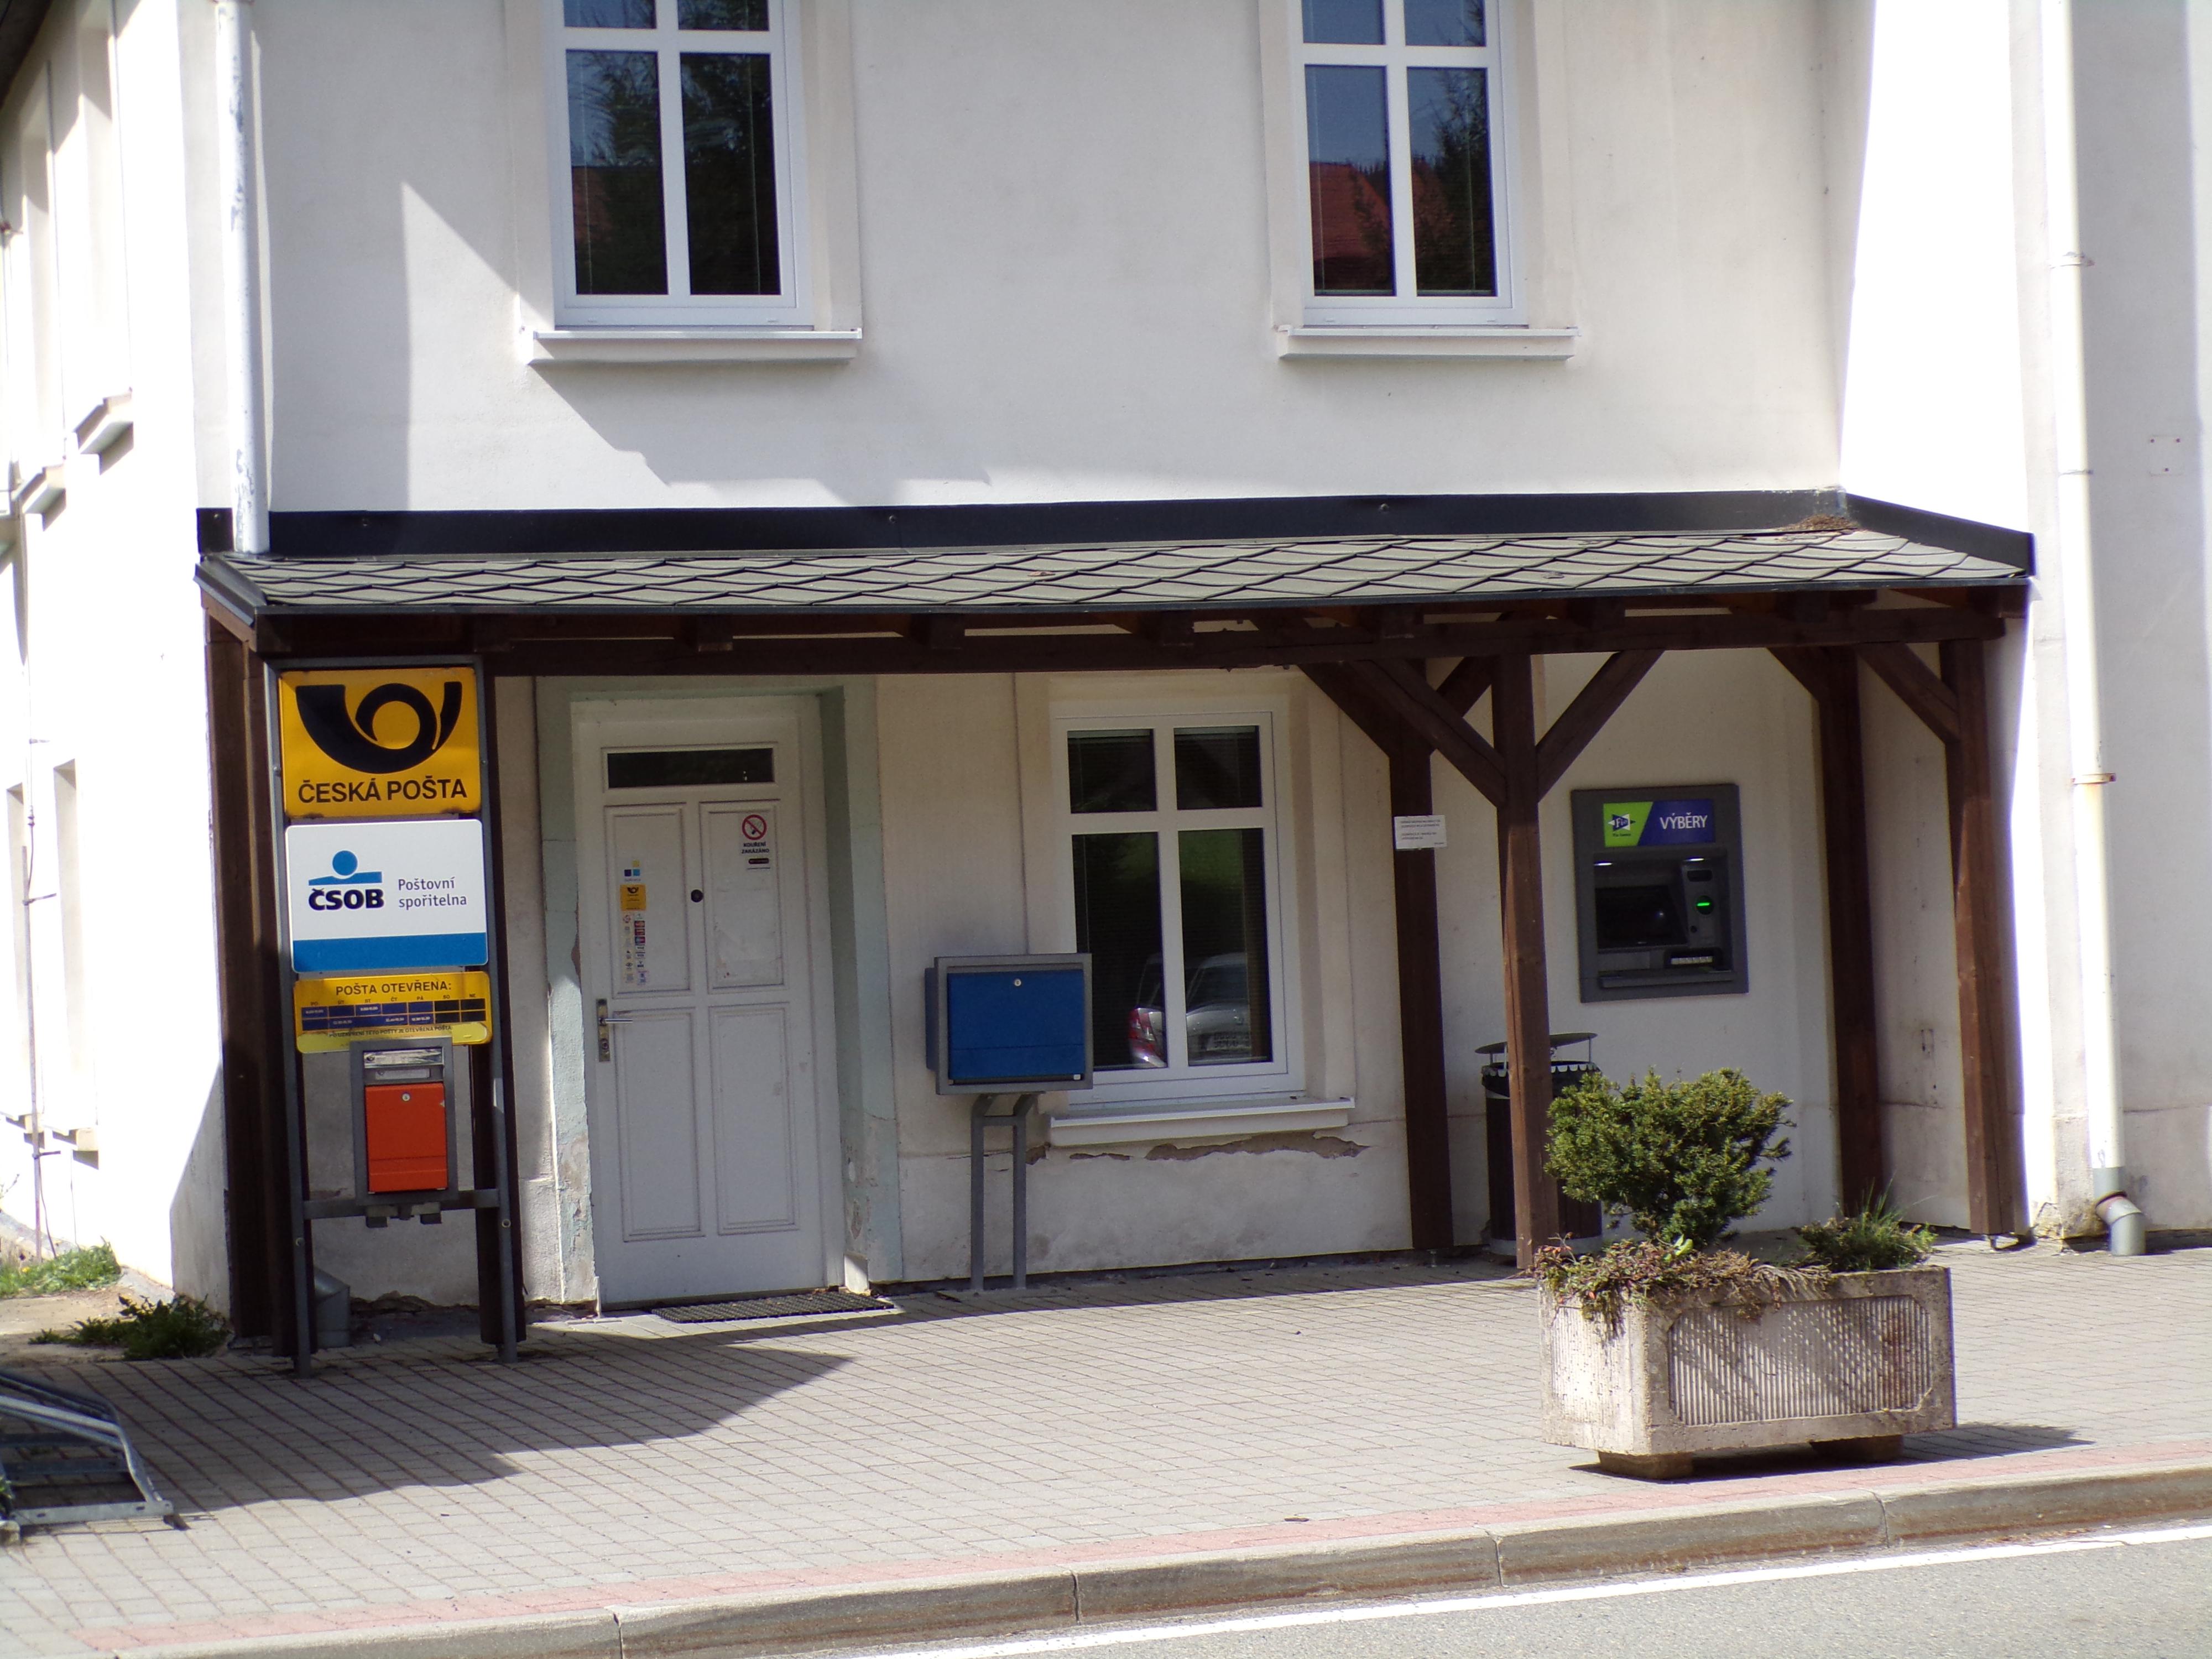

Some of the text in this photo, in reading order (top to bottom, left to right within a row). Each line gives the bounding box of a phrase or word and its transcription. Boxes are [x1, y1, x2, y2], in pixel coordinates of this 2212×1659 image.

[298, 775, 467, 803] ČESKÁ POŠTA
[1660, 811, 1708, 830] VÝBĚRY
[398, 877, 456, 891] Poštovní
[308, 888, 384, 911] ČSOB
[399, 894, 467, 910] spořitelna
[336, 979, 452, 995] POŠTA OTEVŘENA:
